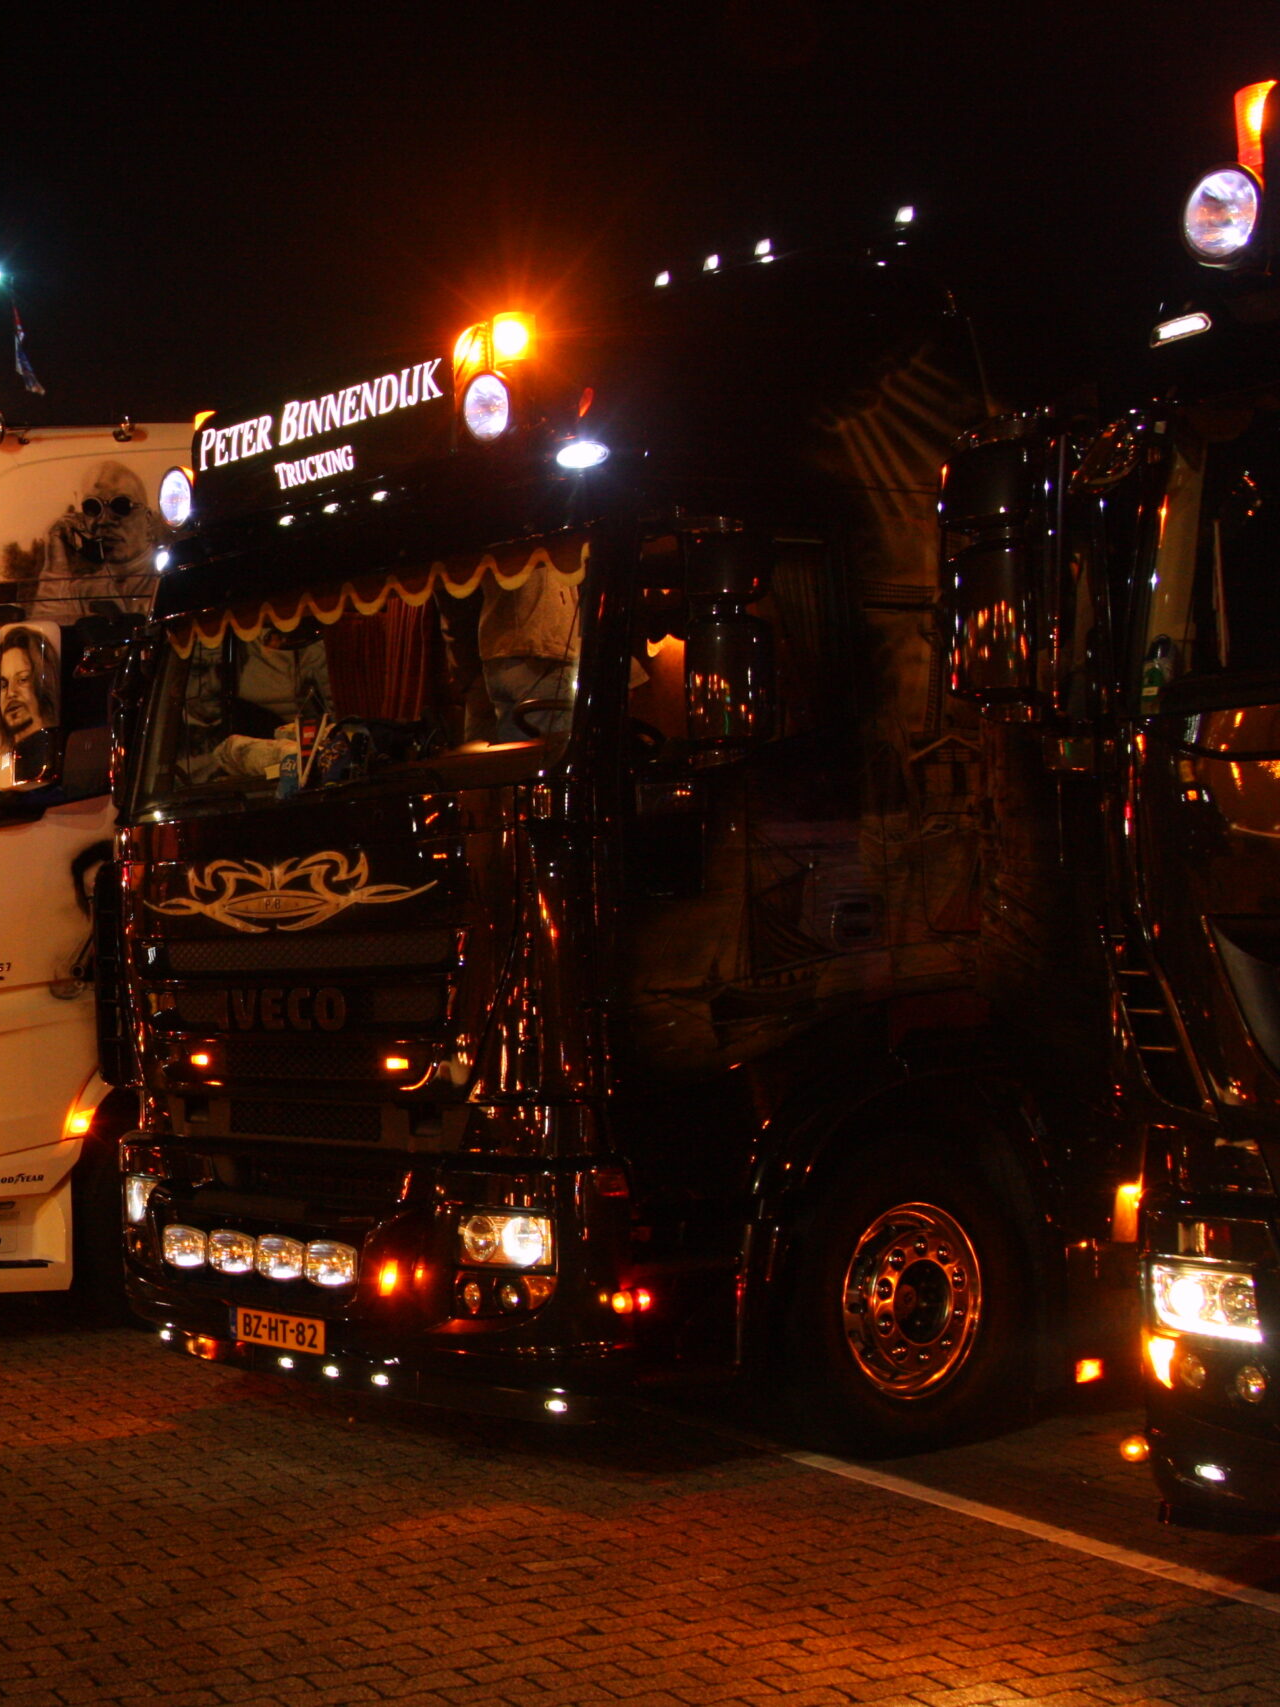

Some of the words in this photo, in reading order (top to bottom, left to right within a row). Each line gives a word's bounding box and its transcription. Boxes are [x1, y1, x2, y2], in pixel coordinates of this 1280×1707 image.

[200, 415, 273, 471] PETER
[279, 358, 443, 446] BINNENDIJK
[274, 445, 354, 490] TRUCKING
[219, 986, 347, 1032] IVECO
[242, 1312, 318, 1349] BZ-HT-82
